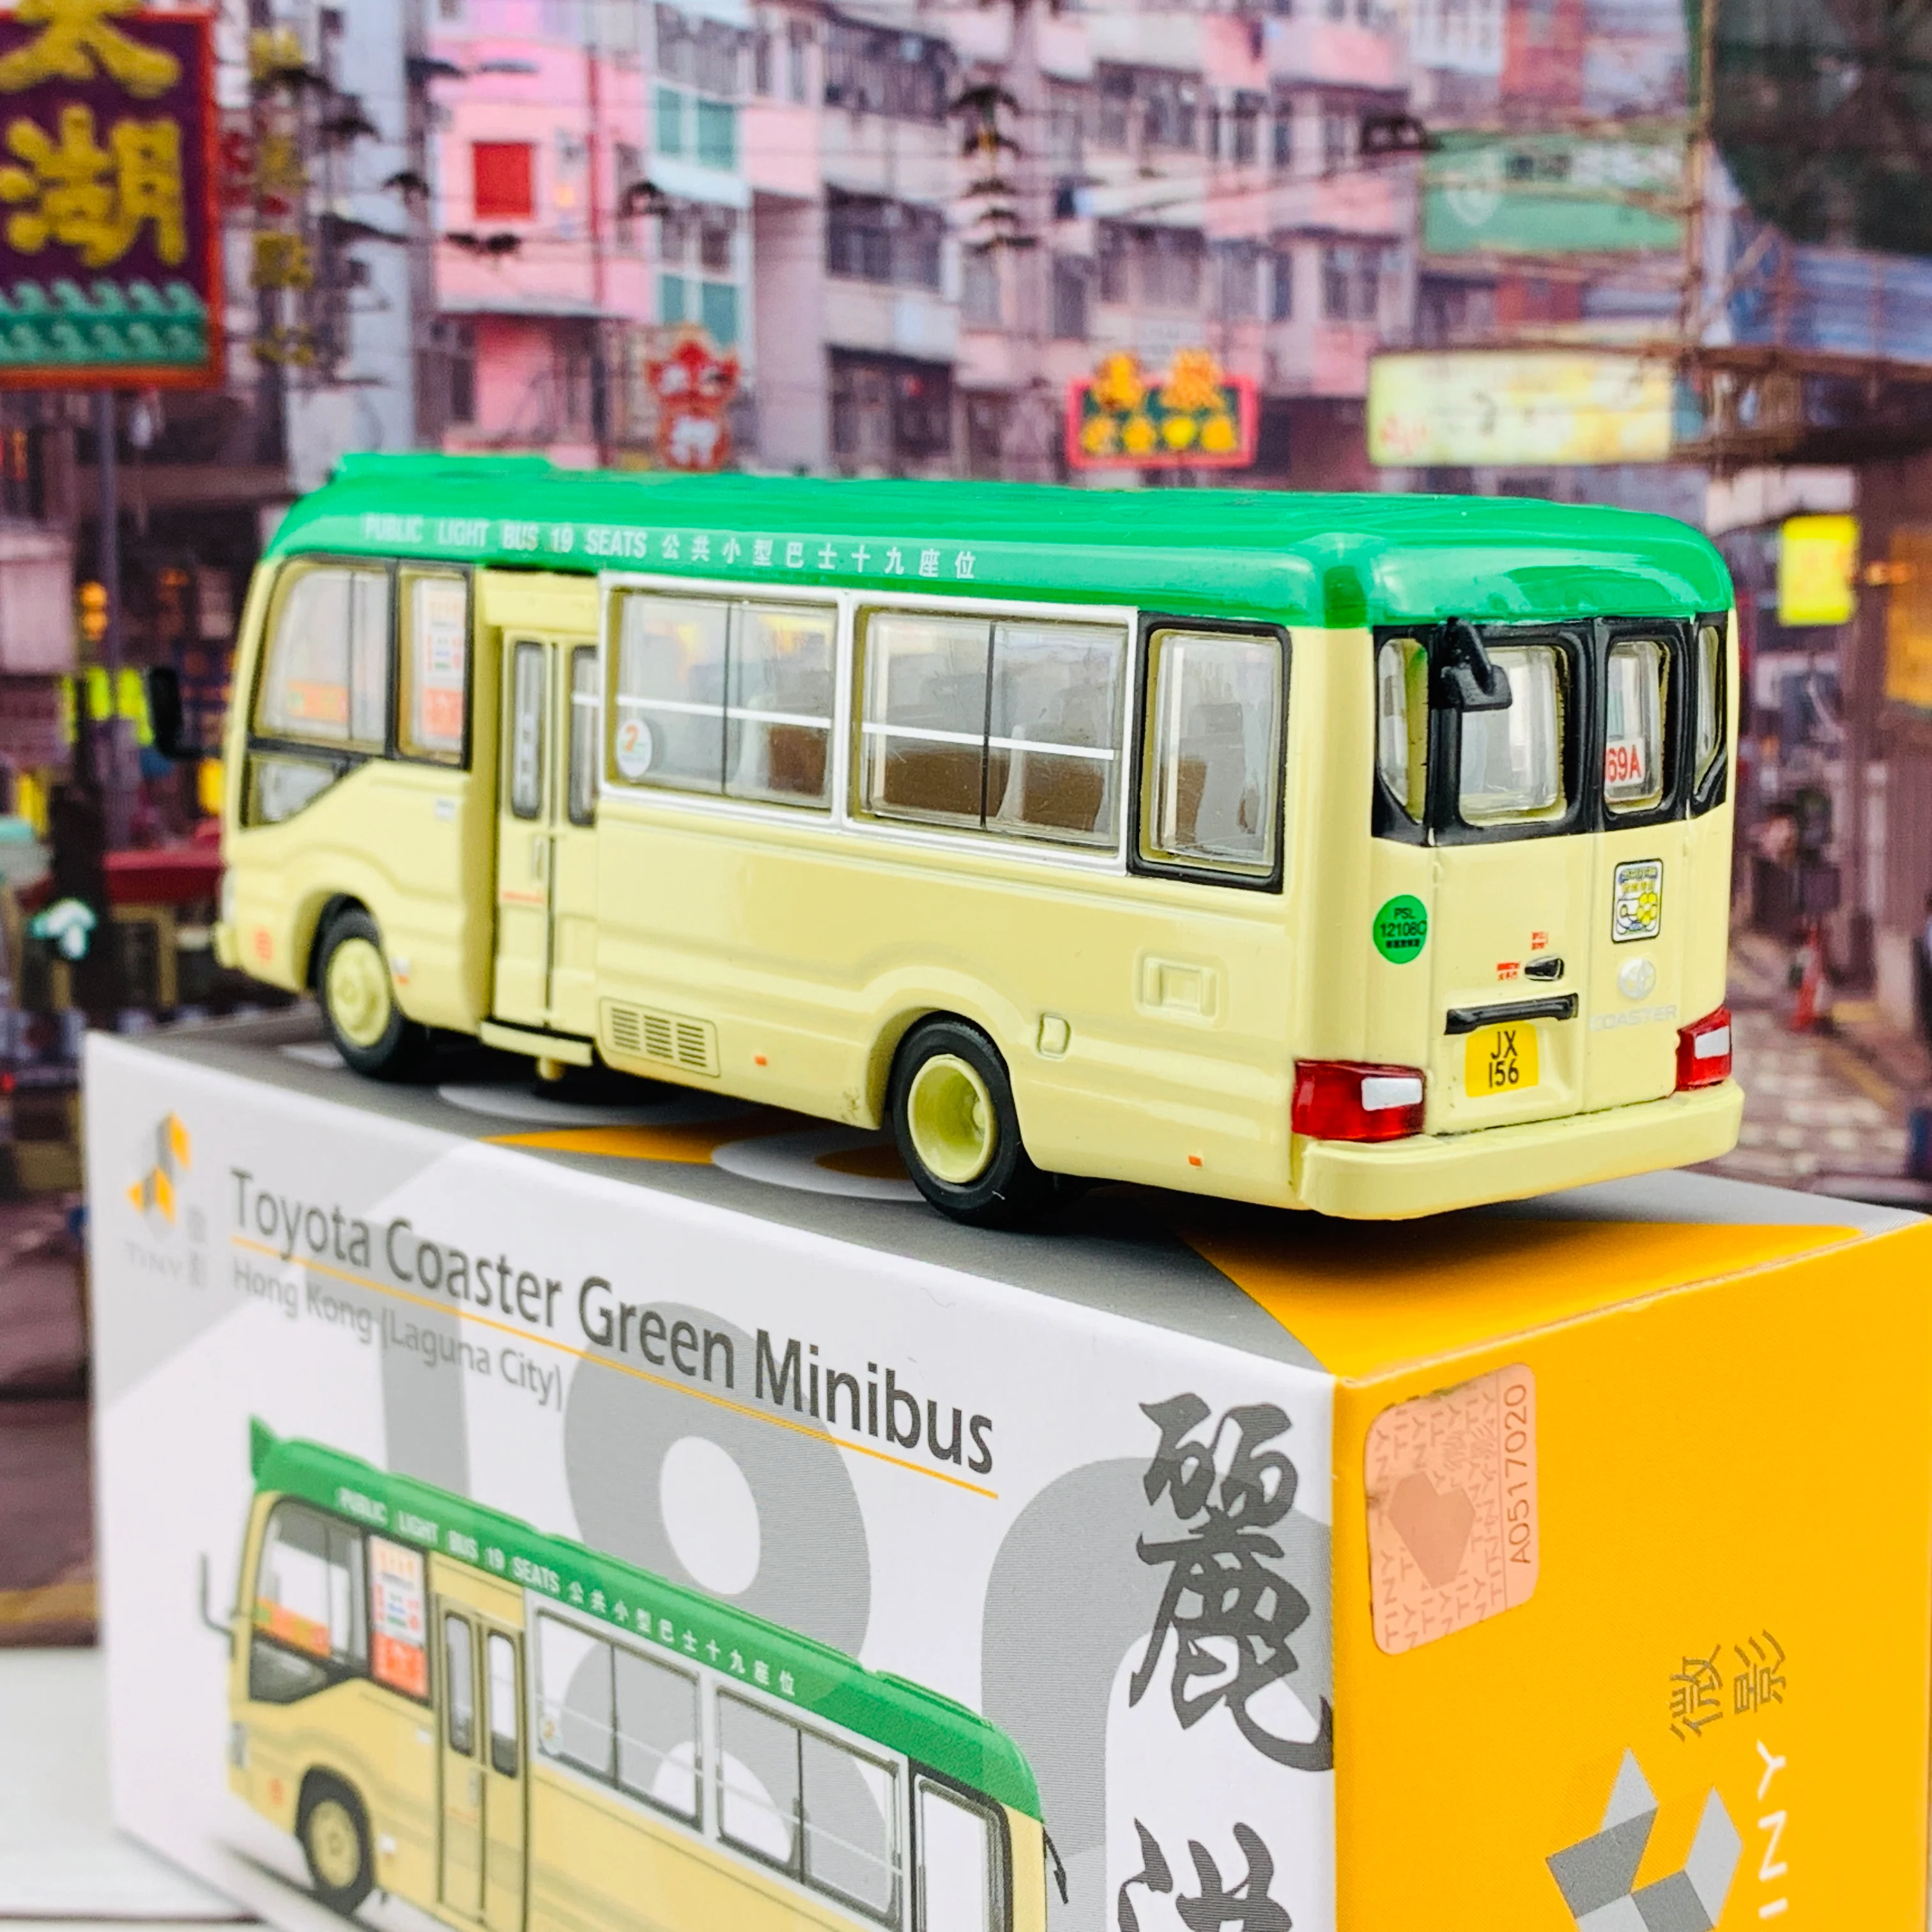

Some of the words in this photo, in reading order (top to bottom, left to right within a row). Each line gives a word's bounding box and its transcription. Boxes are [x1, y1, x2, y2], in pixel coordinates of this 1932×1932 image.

[363, 512, 424, 544] PUBLIC
[438, 517, 489, 548] LIGHT
[502, 519, 538, 551] BUS
[551, 524, 574, 553] 19
[585, 527, 647, 559] SEATS
[1607, 744, 1641, 783] 69A
[1393, 907, 1416, 921] PSL
[1490, 1029, 1518, 1060] JX
[1488, 1058, 1520, 1089] 156
[230, 1167, 372, 1269] Toyota
[385, 1216, 562, 1328] Coaster
[578, 1275, 735, 1390] Green
[755, 1328, 993, 1475] Minibus
[233, 1257, 299, 1319] Hong
[305, 1285, 374, 1344] Kong
[1503, 1383, 1532, 1565] A0517020
[335, 1487, 388, 1525] PUBLIC
[397, 1510, 441, 1545] LIGHT
[447, 1530, 479, 1563] BUS
[484, 1545, 506, 1572] 19
[512, 1556, 560, 1595] SEATS
